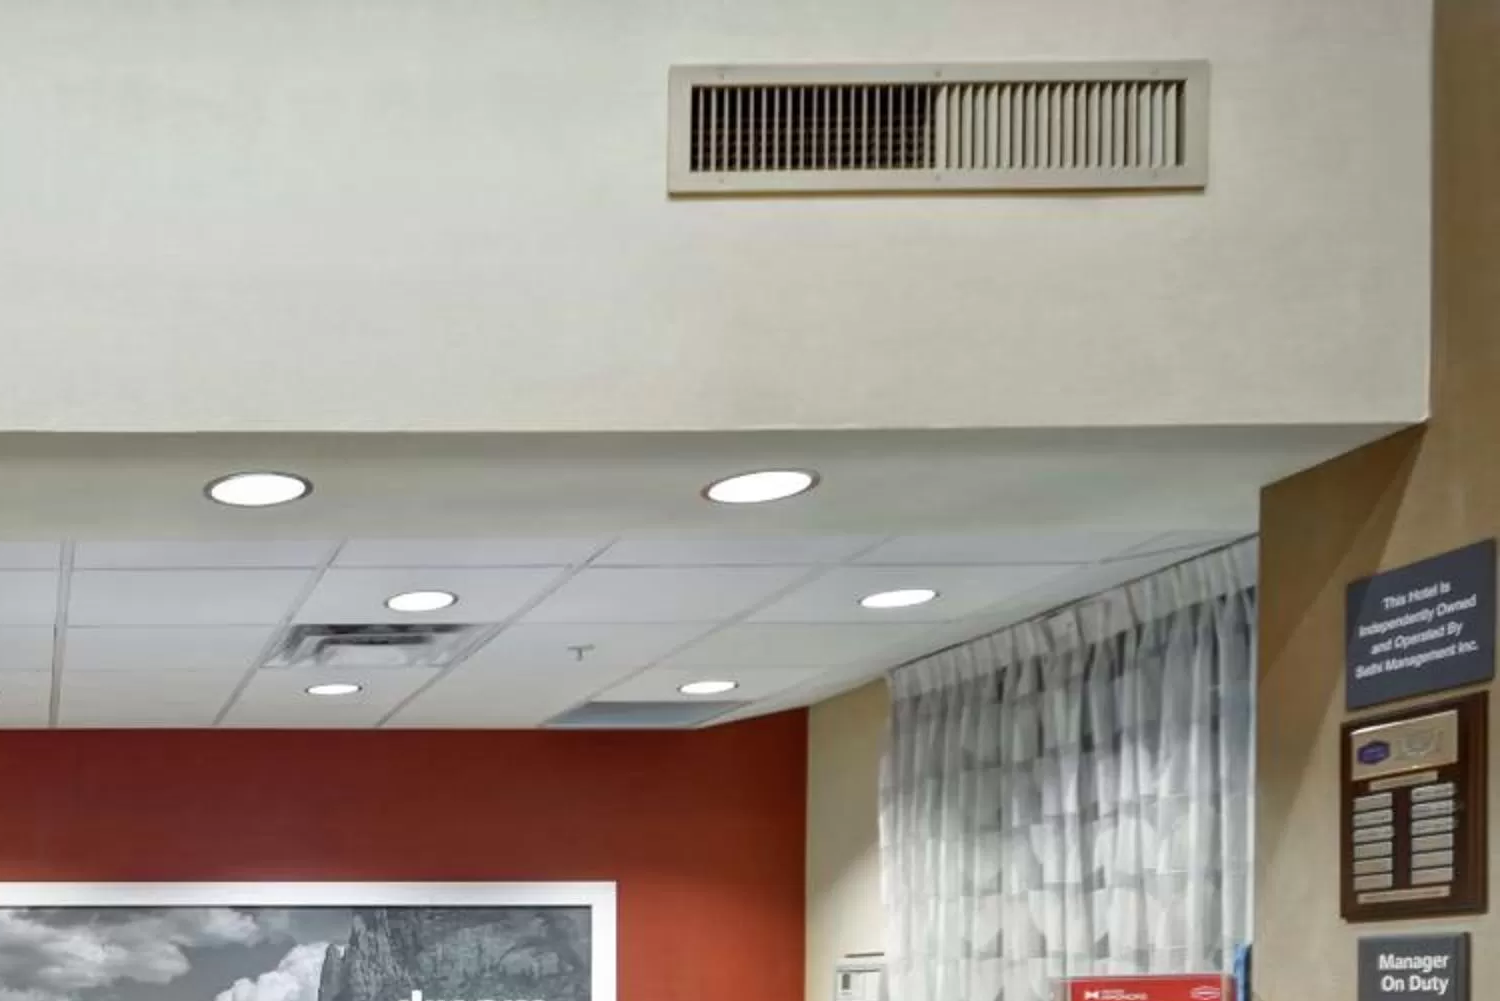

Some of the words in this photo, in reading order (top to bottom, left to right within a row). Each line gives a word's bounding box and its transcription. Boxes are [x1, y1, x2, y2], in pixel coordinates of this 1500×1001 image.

[1381, 596, 1406, 610] This
[1407, 584, 1438, 602] Hotel
[1436, 593, 1477, 617] Owned
[1370, 638, 1393, 655] and
[1394, 625, 1445, 650] Operated
[1446, 621, 1464, 637] By
[1384, 644, 1456, 671] Management
[1378, 953, 1449, 973] Manager
[1380, 975, 1405, 992] On
[1409, 975, 1449, 995] Duty
